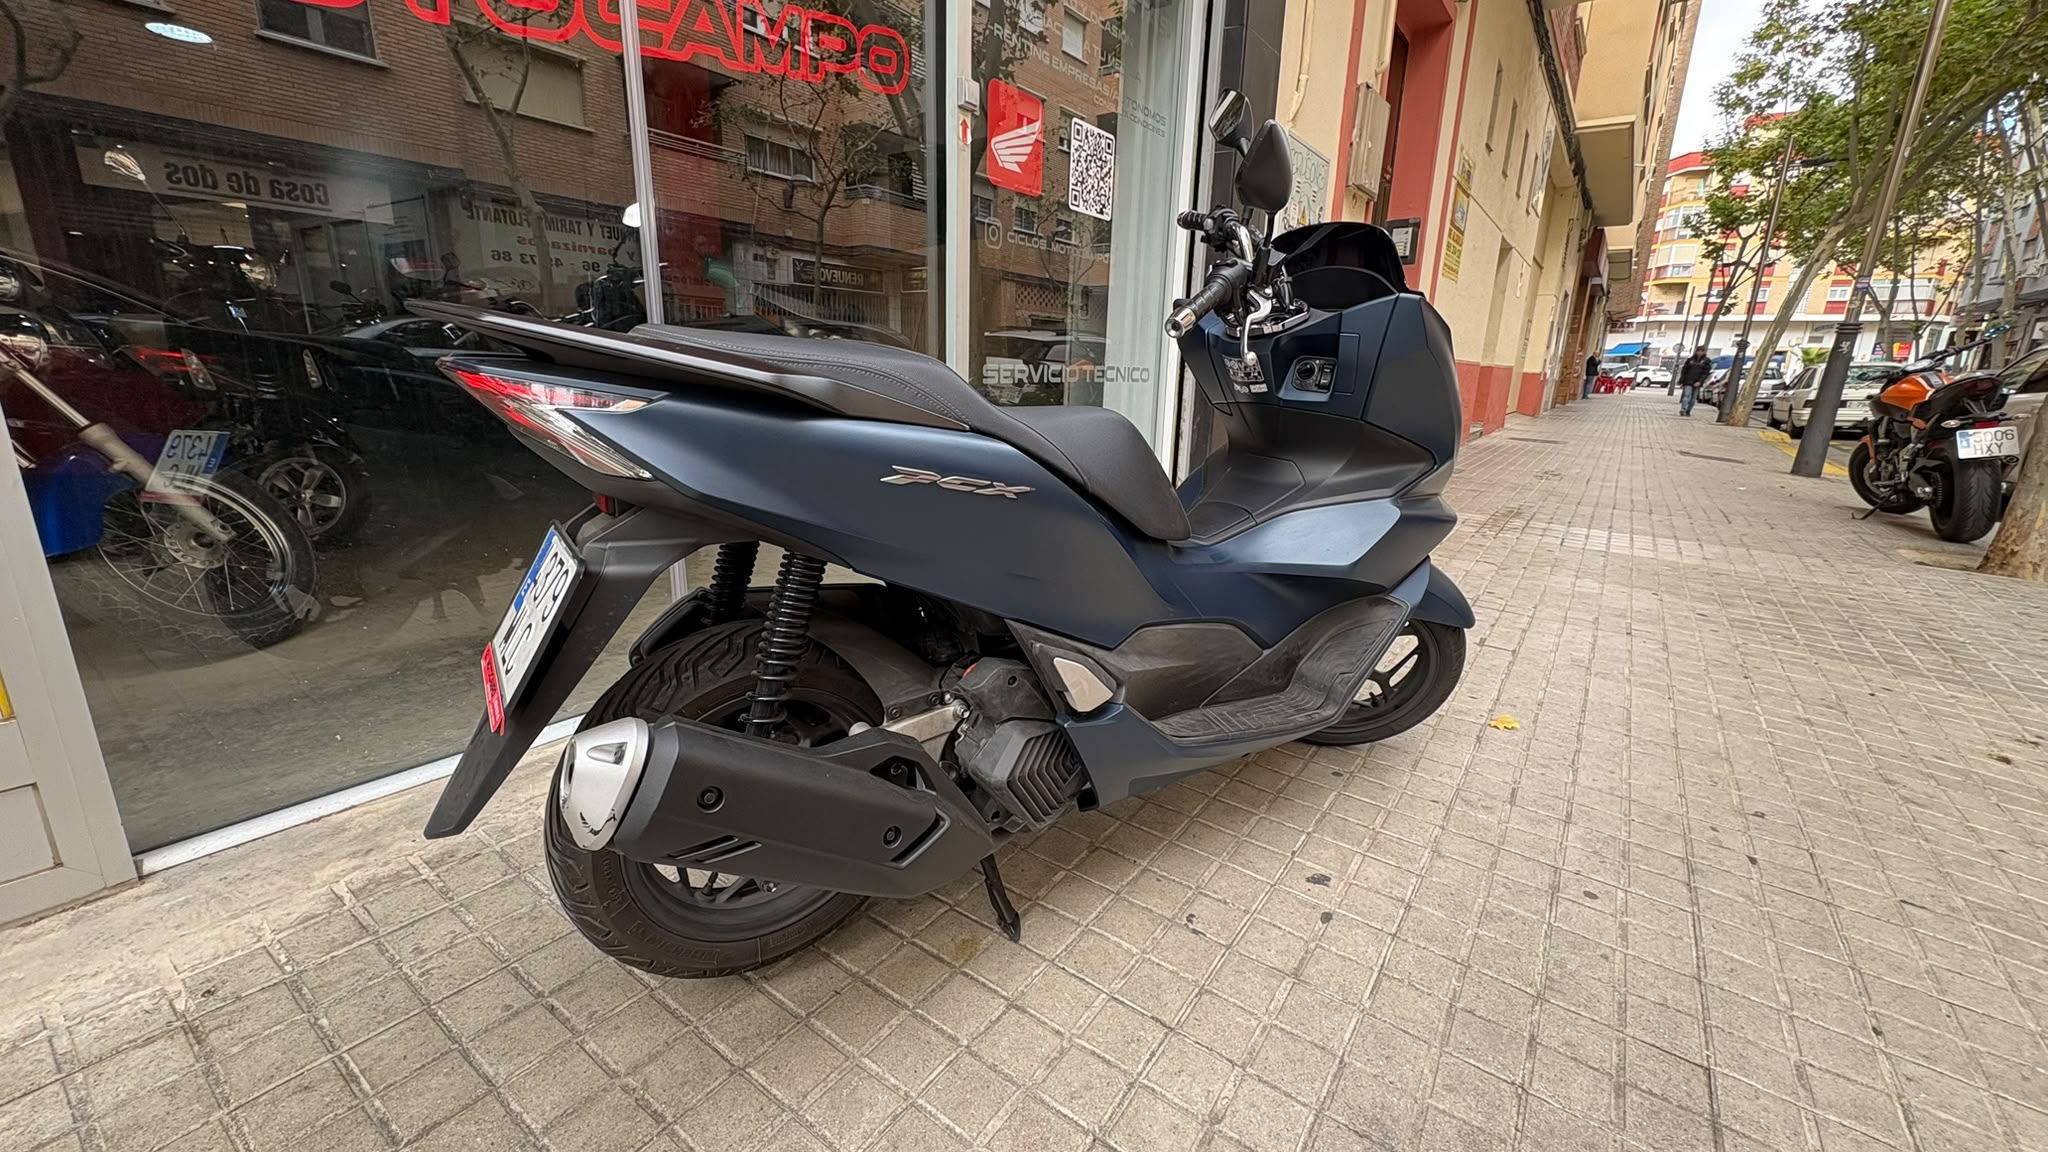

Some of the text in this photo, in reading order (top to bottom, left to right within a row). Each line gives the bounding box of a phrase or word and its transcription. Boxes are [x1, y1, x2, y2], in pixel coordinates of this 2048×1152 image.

[982, 363, 1151, 384] SERVICIO TECNICO
[1972, 428, 2015, 443] 5006
[1973, 441, 2004, 455] HXY
[880, 464, 1036, 499] PCX
